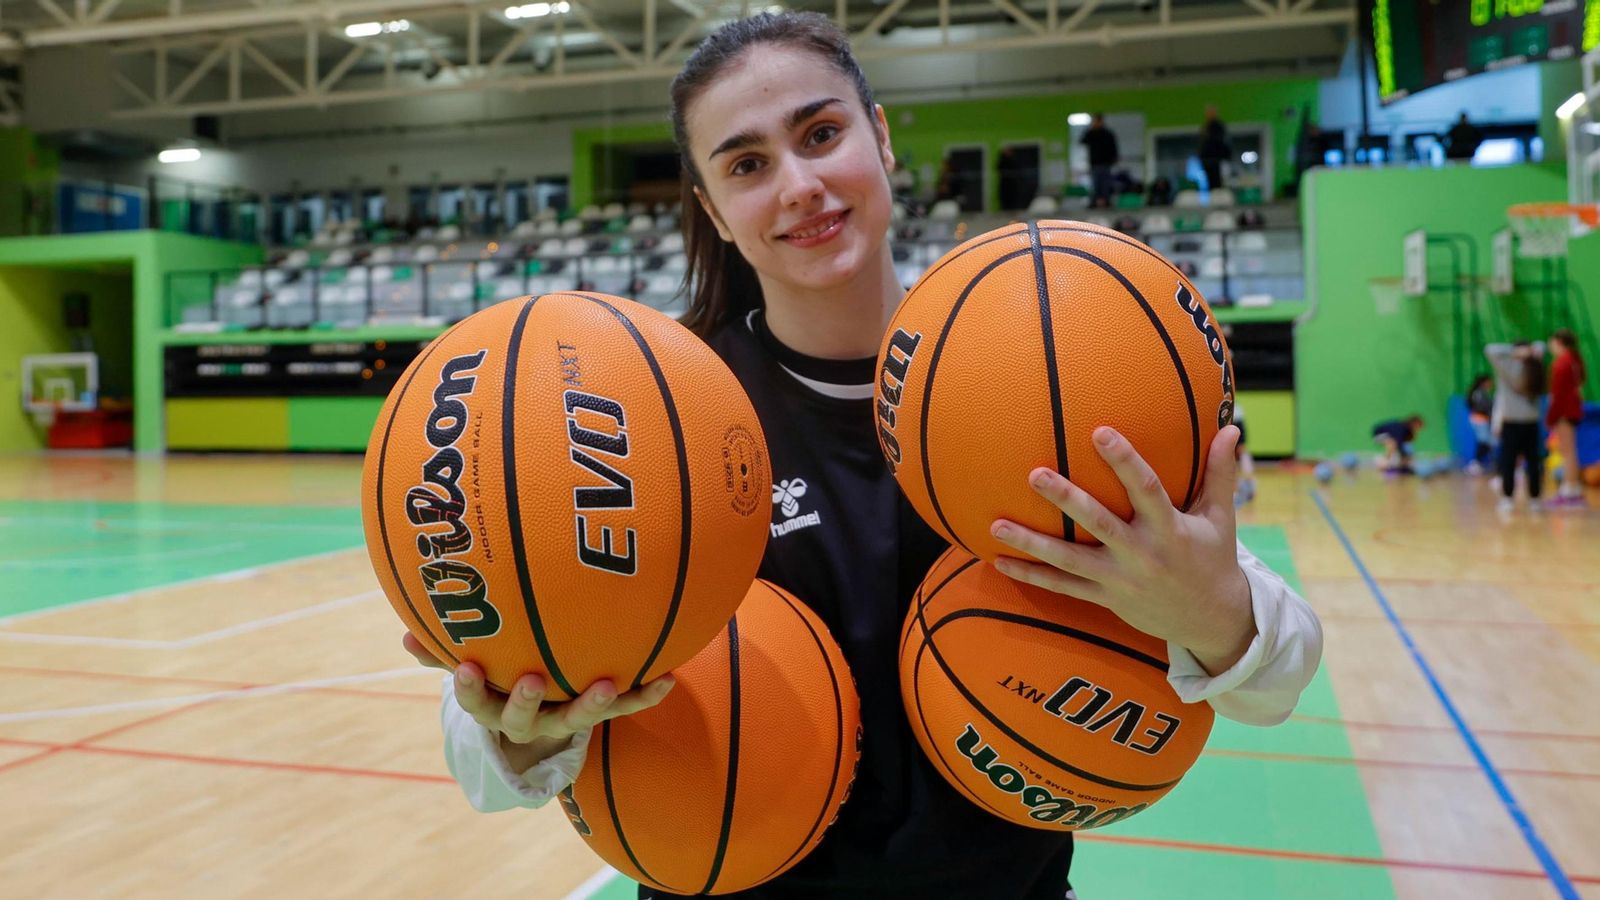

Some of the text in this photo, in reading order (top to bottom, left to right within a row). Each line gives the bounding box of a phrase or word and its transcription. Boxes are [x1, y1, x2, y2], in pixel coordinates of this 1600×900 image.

[404, 348, 502, 646] Wilson
[473, 411, 494, 564] INDOOR GAME BALL
[557, 340, 638, 577] EVO NXT
[770, 510, 821, 538] hummel
[997, 674, 1181, 755] EVO NXT
[1018, 761, 1116, 804] INDOOR GAME BALL
